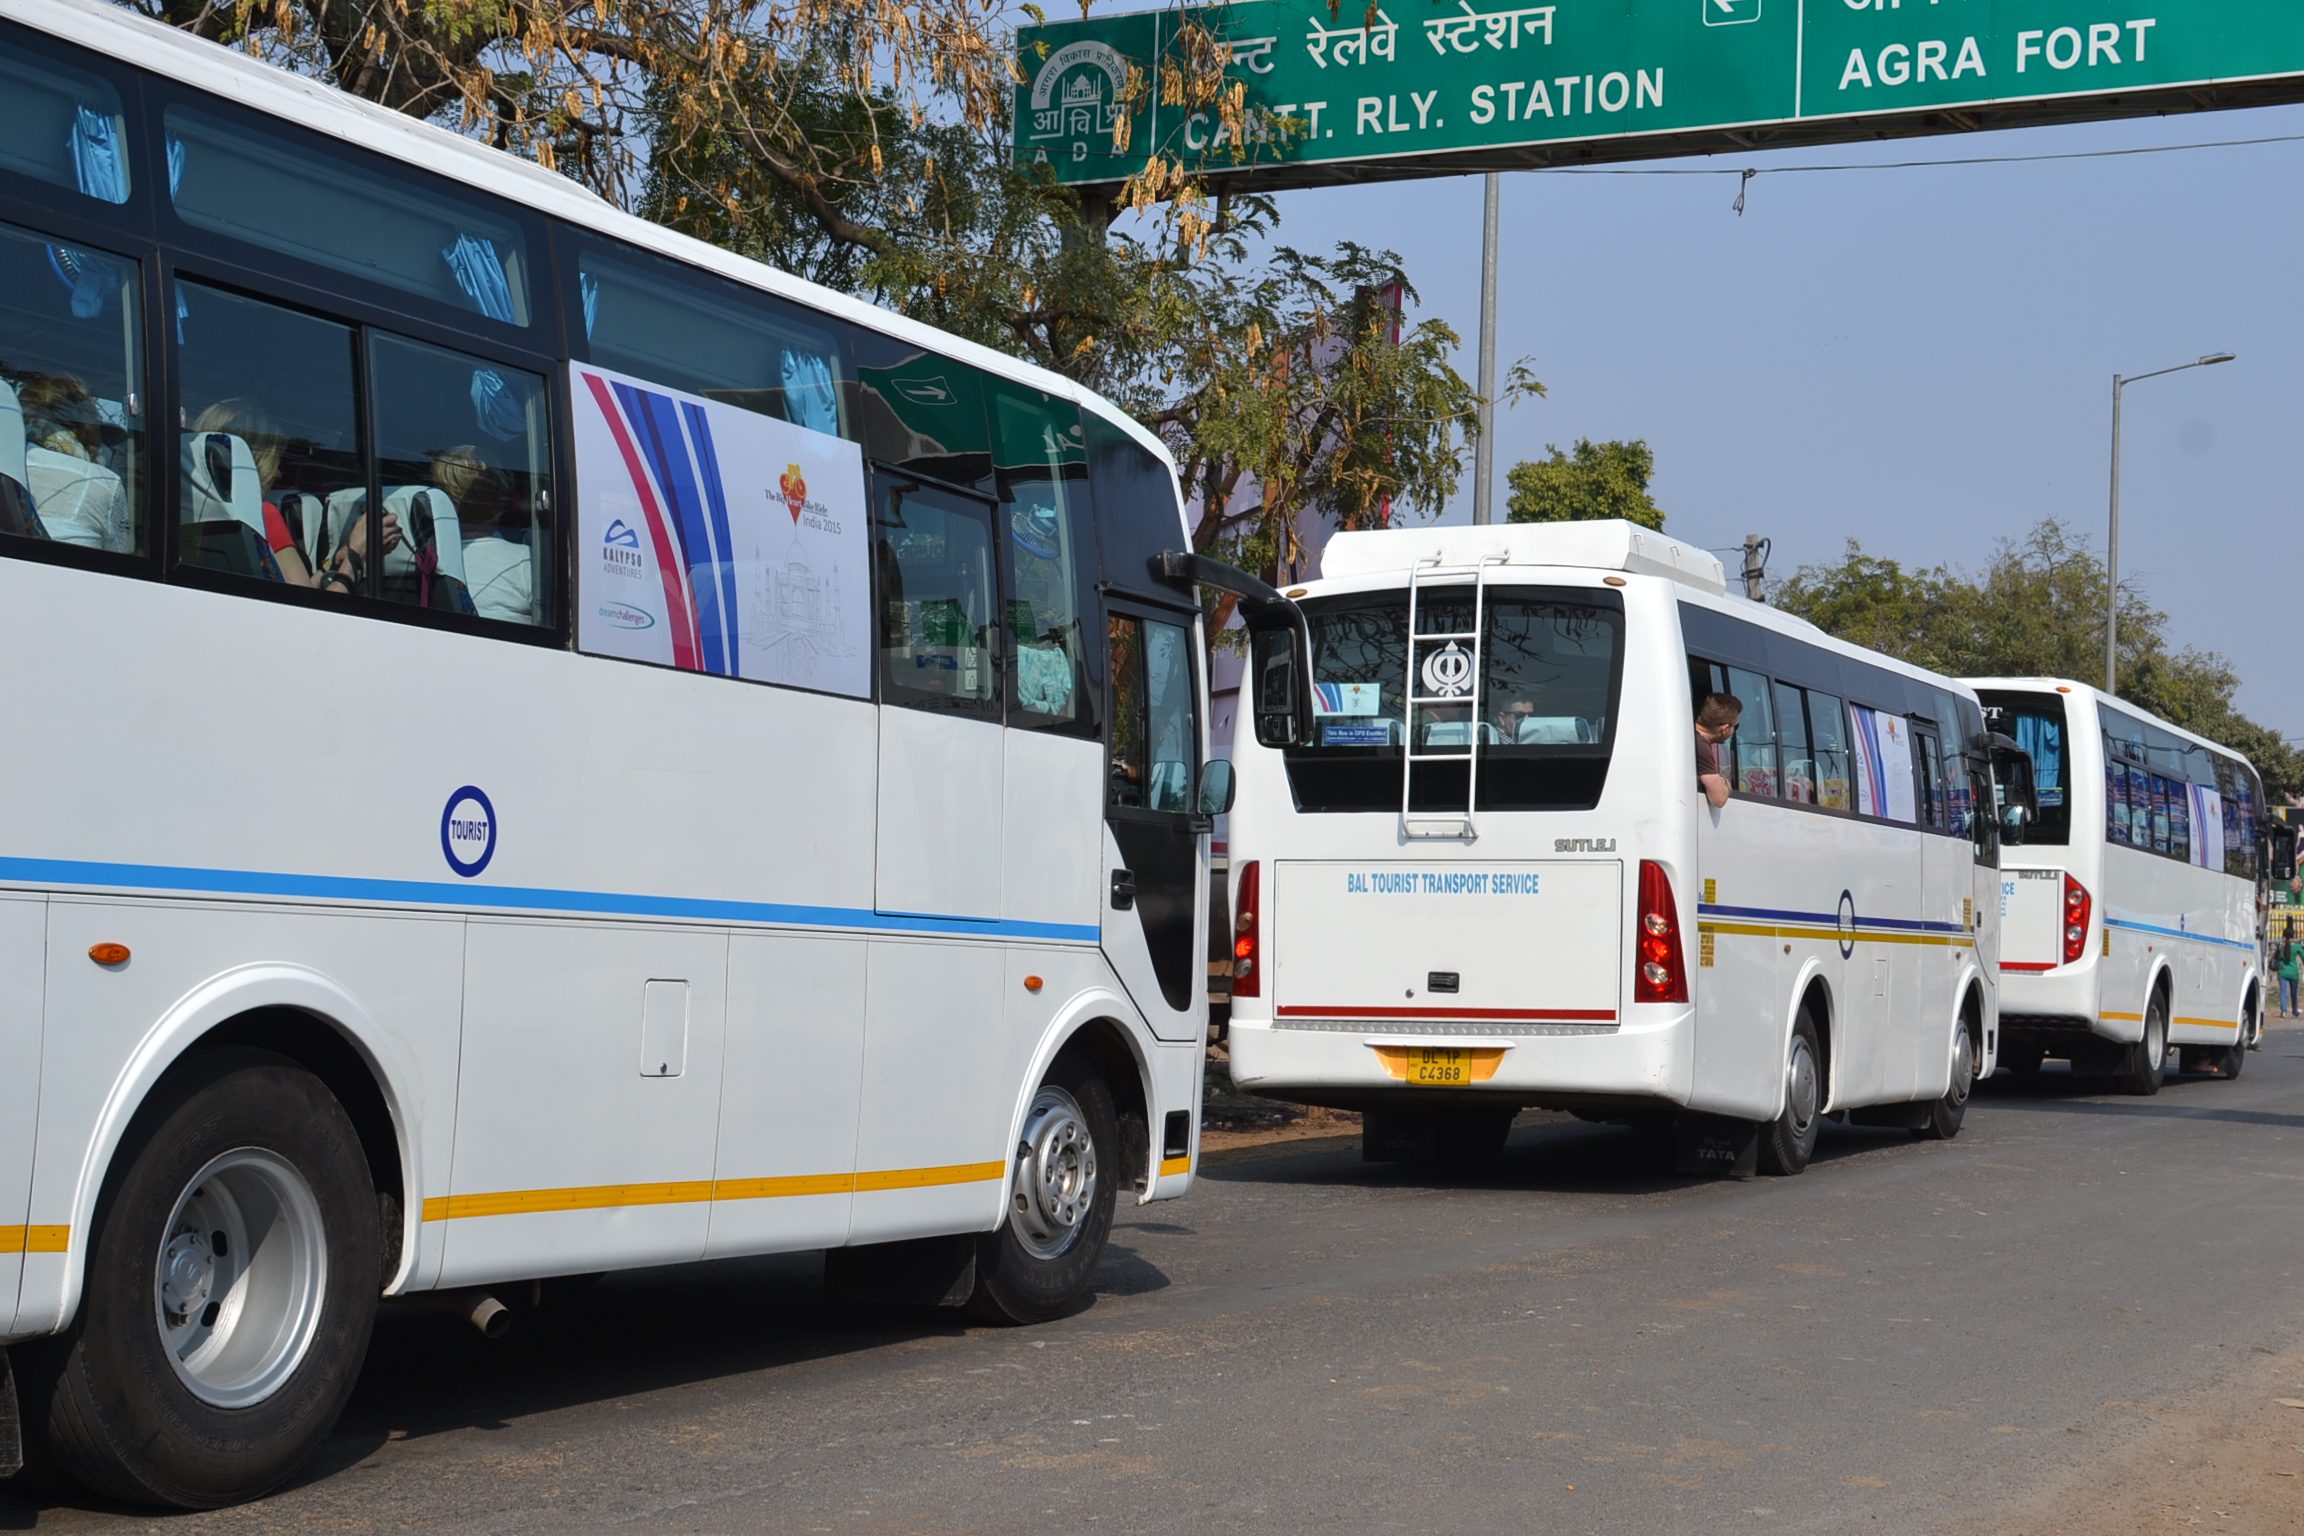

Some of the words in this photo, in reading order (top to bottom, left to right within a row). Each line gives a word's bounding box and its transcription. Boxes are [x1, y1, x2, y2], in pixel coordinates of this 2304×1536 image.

[1306, 9, 1399, 69] रेलवे
[1423, 0, 1557, 56] स्टेशन
[1838, 36, 1987, 90] AGRA
[2017, 18, 2156, 73] FORT
[1357, 90, 1444, 135] RLY.
[1470, 67, 1663, 125] STATION
[1072, 141, 1087, 162] D
[803, 514, 822, 530] India
[823, 519, 842, 535] 2015
[603, 547, 642, 567] KALYPSO
[603, 563, 642, 580] ADVENTURES
[599, 606, 645, 626] dreamchallenges
[452, 820, 487, 841] TOURIST
[1554, 838, 1617, 852] SUTLEJ
[1348, 873, 1369, 893] BAL
[1371, 873, 1419, 894] TOURIST
[1422, 873, 1489, 894] TRANSPORT
[1492, 873, 1540, 895] SERVICE
[1422, 1050, 1439, 1064] DL
[1446, 1050, 1460, 1065] 1P
[1420, 1066, 1461, 1081] C4368
[1696, 1149, 1735, 1161] TATA
